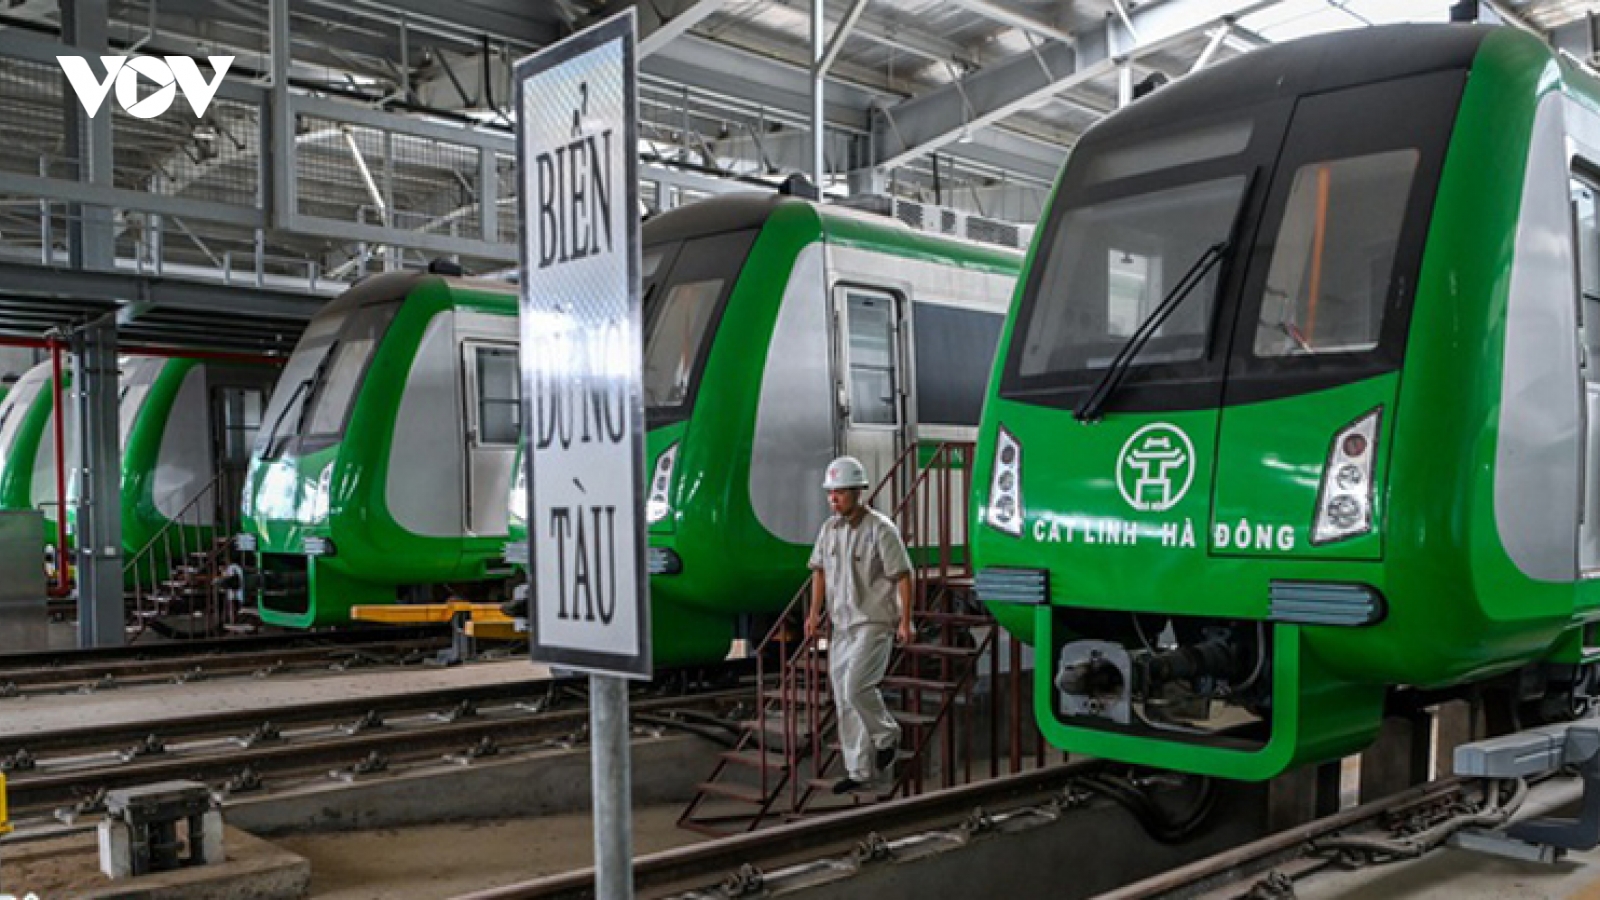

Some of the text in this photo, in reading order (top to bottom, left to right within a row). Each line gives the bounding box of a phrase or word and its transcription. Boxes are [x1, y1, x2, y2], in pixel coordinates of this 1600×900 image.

[536, 81, 613, 268] BIỂN
[550, 477, 616, 626] TÀU
[1083, 520, 1137, 545] LINH
[1161, 518, 1196, 547] HÀ
[1213, 518, 1295, 550] ĐÔNG
